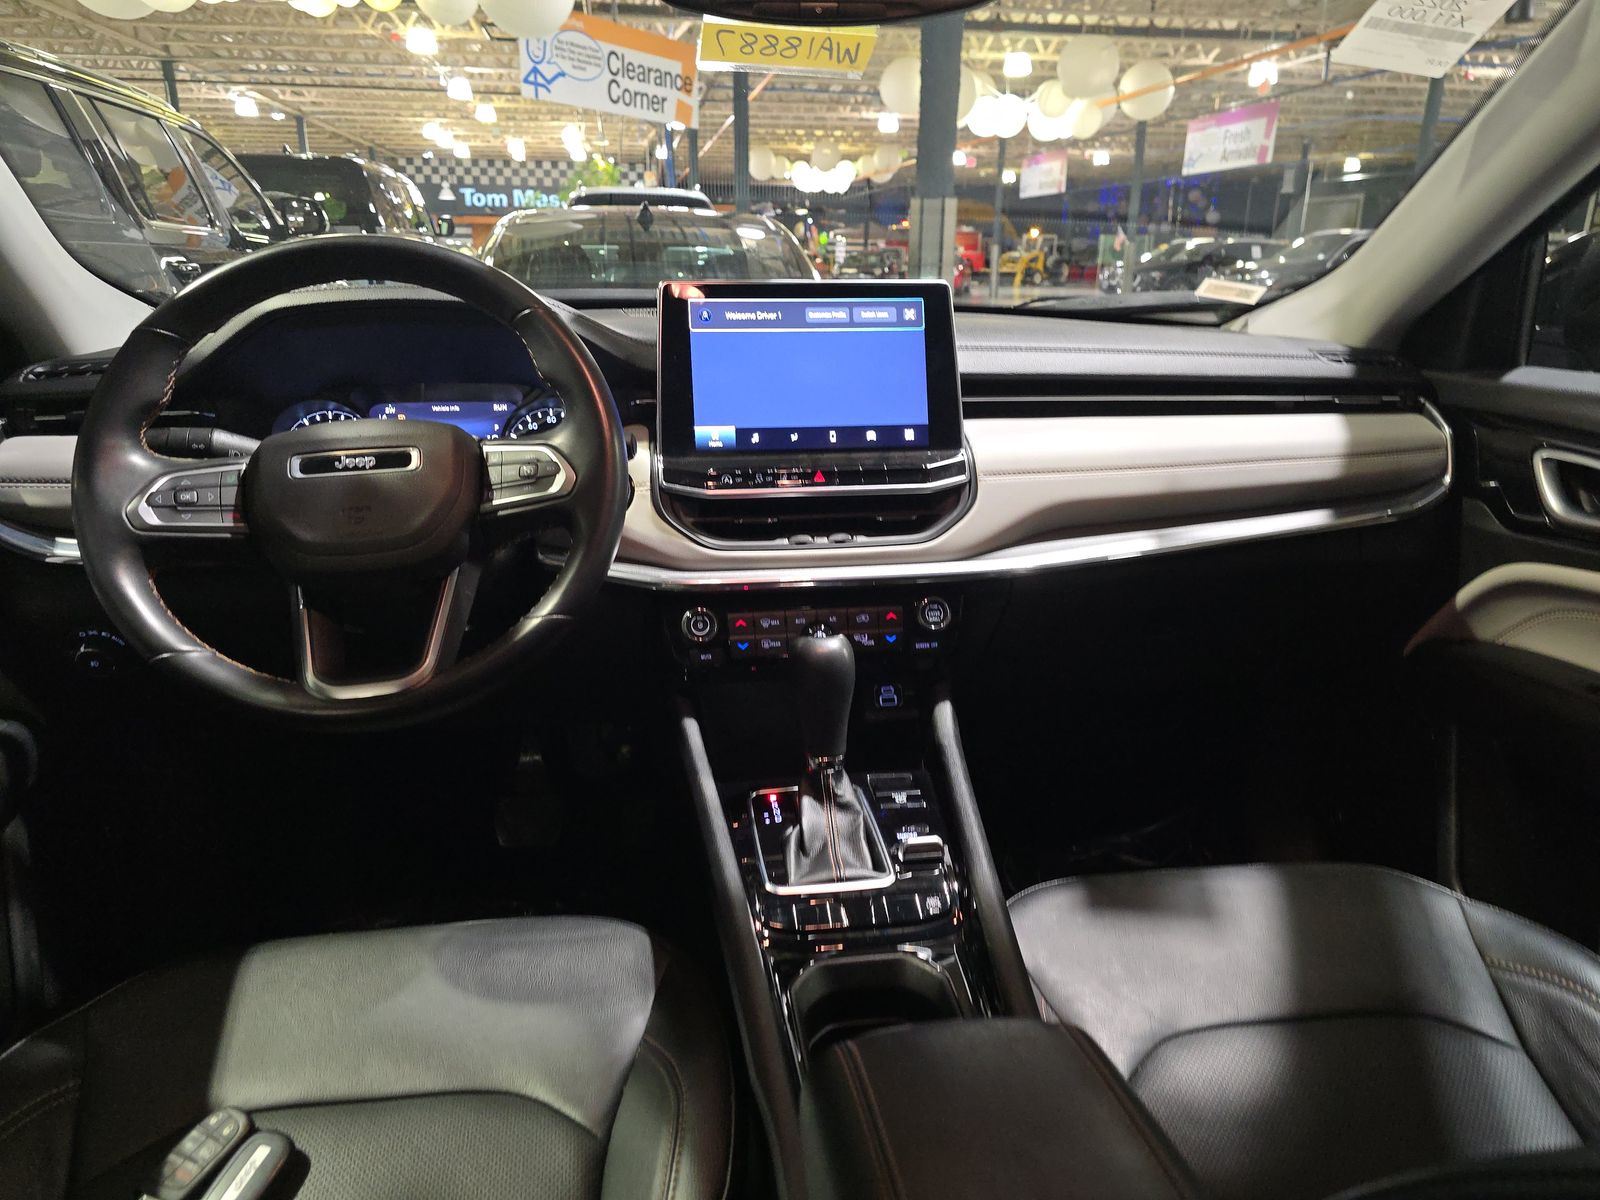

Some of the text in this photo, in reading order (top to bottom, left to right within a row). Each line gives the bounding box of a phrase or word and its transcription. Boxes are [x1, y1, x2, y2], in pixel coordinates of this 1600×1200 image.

[607, 50, 694, 95] Clearance
[608, 78, 668, 115] Corner
[1222, 126, 1252, 145] Fresh
[1219, 143, 1258, 164] Arrivals
[458, 187, 508, 208] Tom
[725, 311, 756, 321] Welcome
[756, 311, 777, 321] Driver
[492, 403, 508, 412] RUN
[546, 415, 557, 424] 80
[494, 423, 500, 432] P
[527, 421, 539, 431] 60
[334, 456, 376, 470] Jeep
[180, 493, 191, 501] OK
